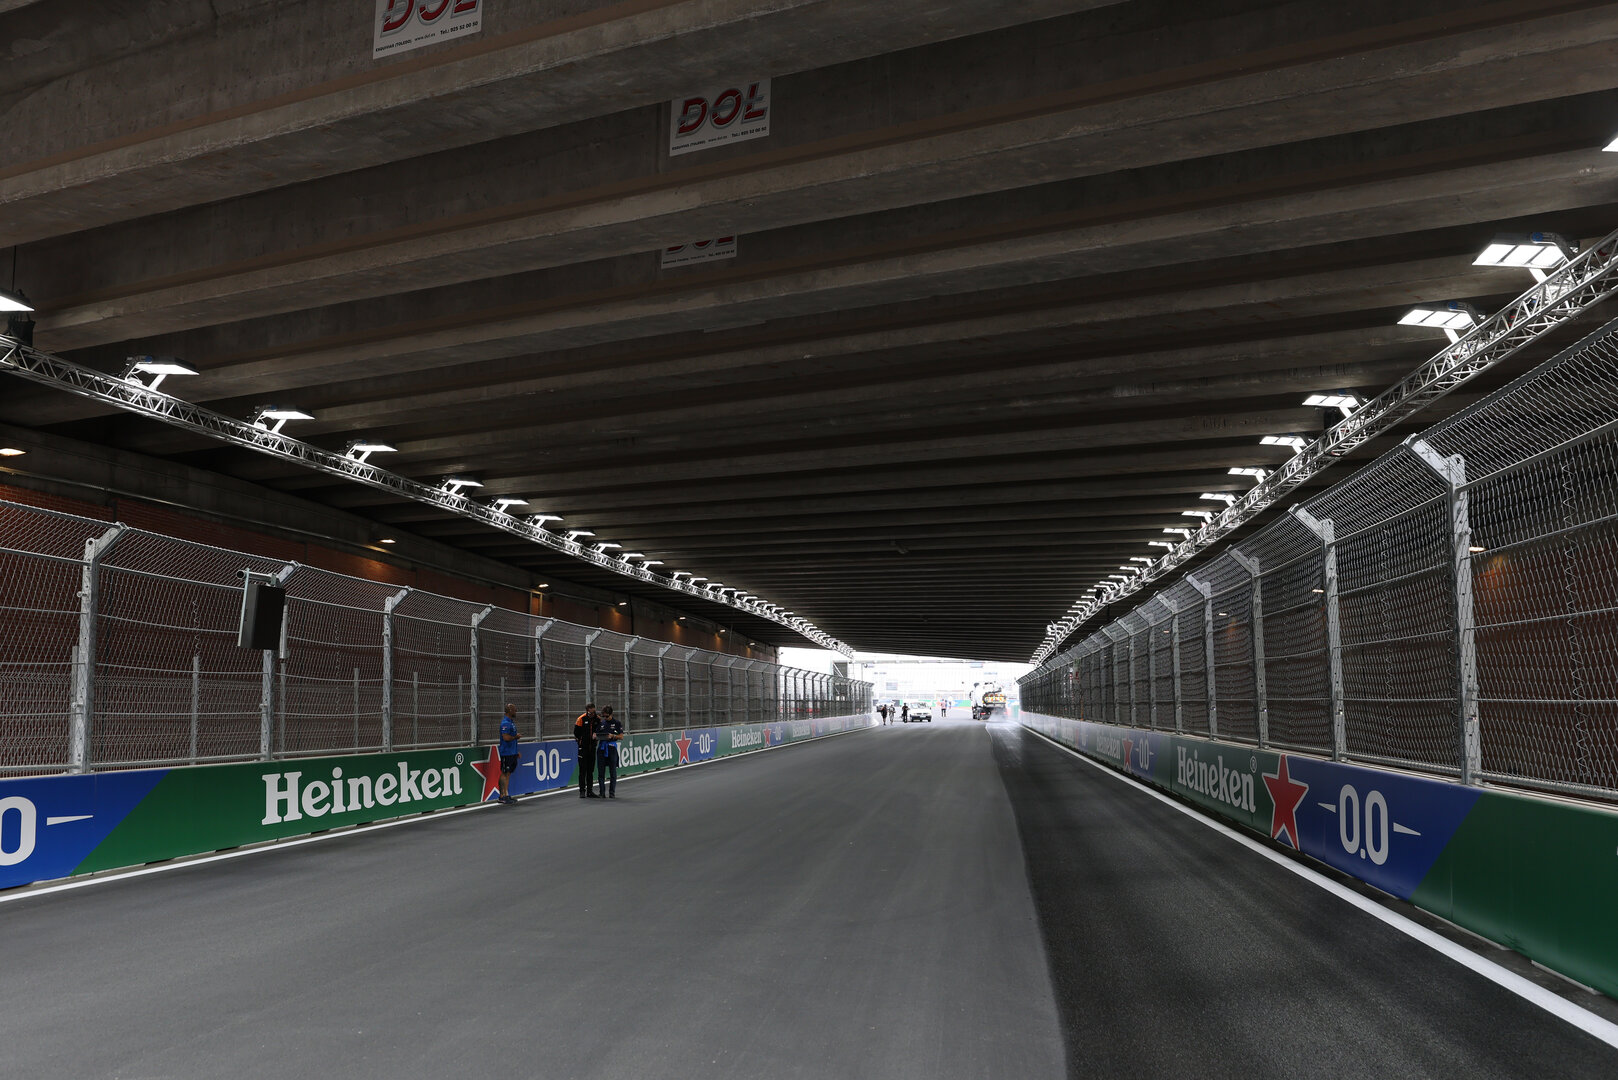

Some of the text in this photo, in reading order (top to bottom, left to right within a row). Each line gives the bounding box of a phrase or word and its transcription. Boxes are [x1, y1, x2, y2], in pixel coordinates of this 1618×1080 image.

[675, 82, 767, 138] DOL
[261, 761, 463, 825] Heineken
[535, 748, 560, 781] 0.0
[1177, 746, 1256, 813] Heineken
[1339, 784, 1389, 866] 0.0
